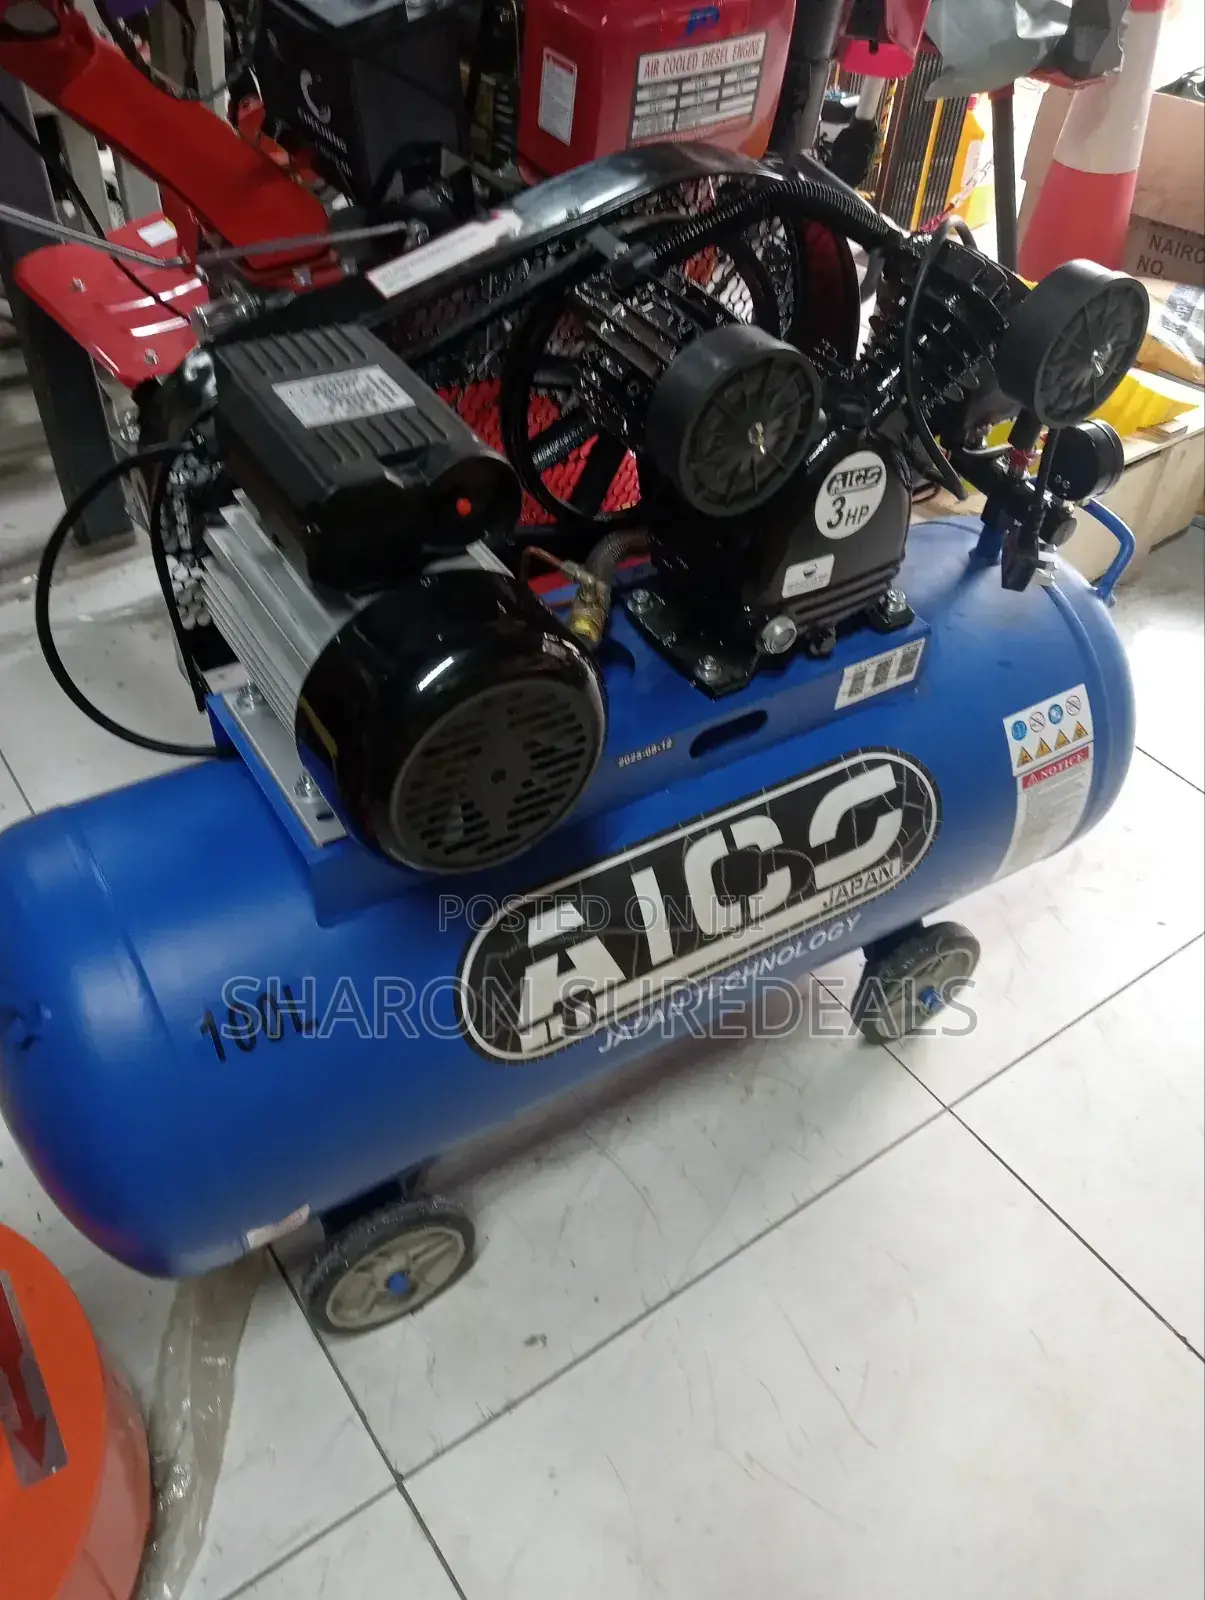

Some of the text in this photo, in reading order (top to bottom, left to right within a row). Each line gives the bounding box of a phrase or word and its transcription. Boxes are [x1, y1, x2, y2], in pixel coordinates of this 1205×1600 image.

[643, 38, 762, 80] AIR COOLED DIESEL ENGINE
[1039, 750, 1086, 781] NOTICE
[822, 857, 901, 908] JAPAN
[518, 763, 905, 1052] AICO
